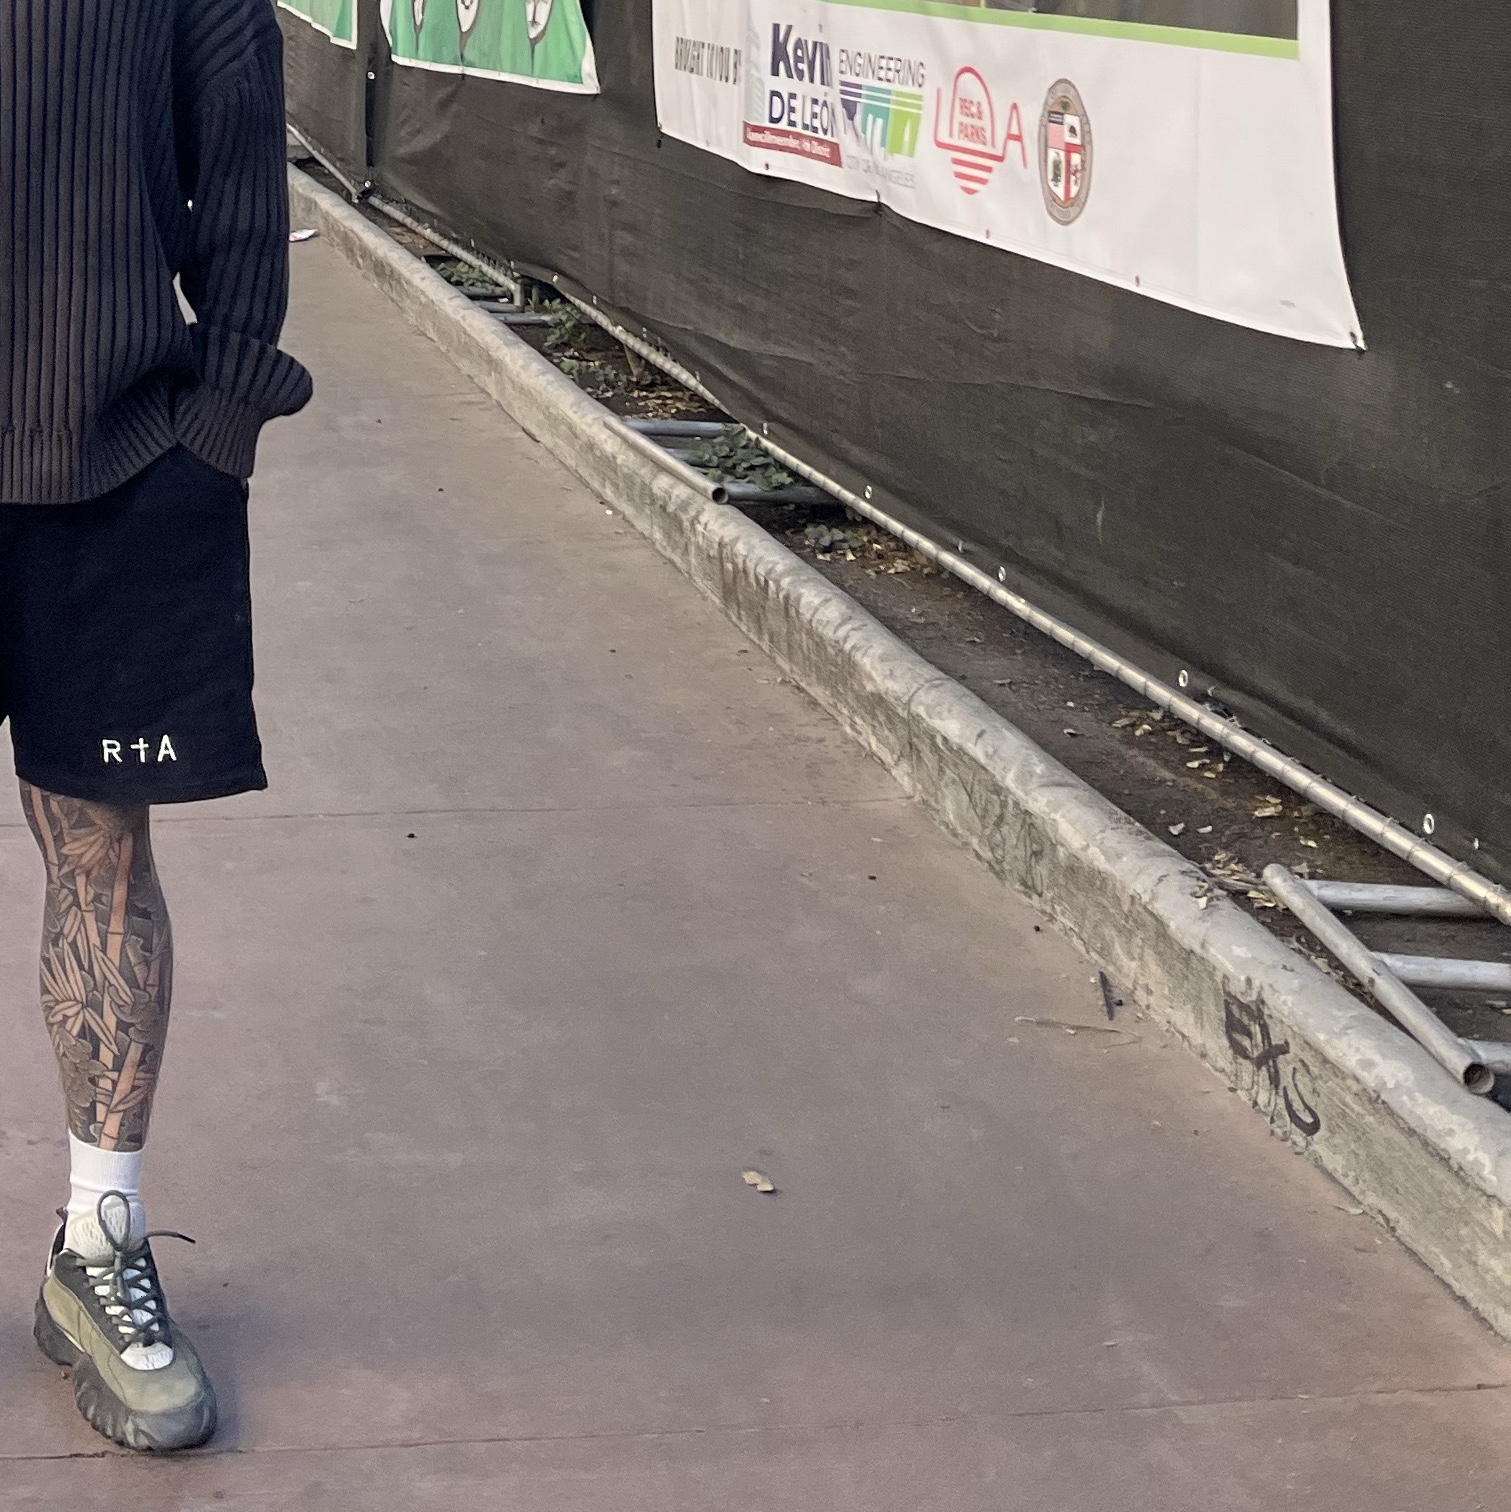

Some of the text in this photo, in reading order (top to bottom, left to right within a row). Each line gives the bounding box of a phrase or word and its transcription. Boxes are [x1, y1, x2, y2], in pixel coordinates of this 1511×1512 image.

[771, 22, 833, 87] Kevin
[839, 48, 926, 88] ENGINEERING
[768, 89, 798, 128] DE
[958, 121, 987, 146] PARKS
